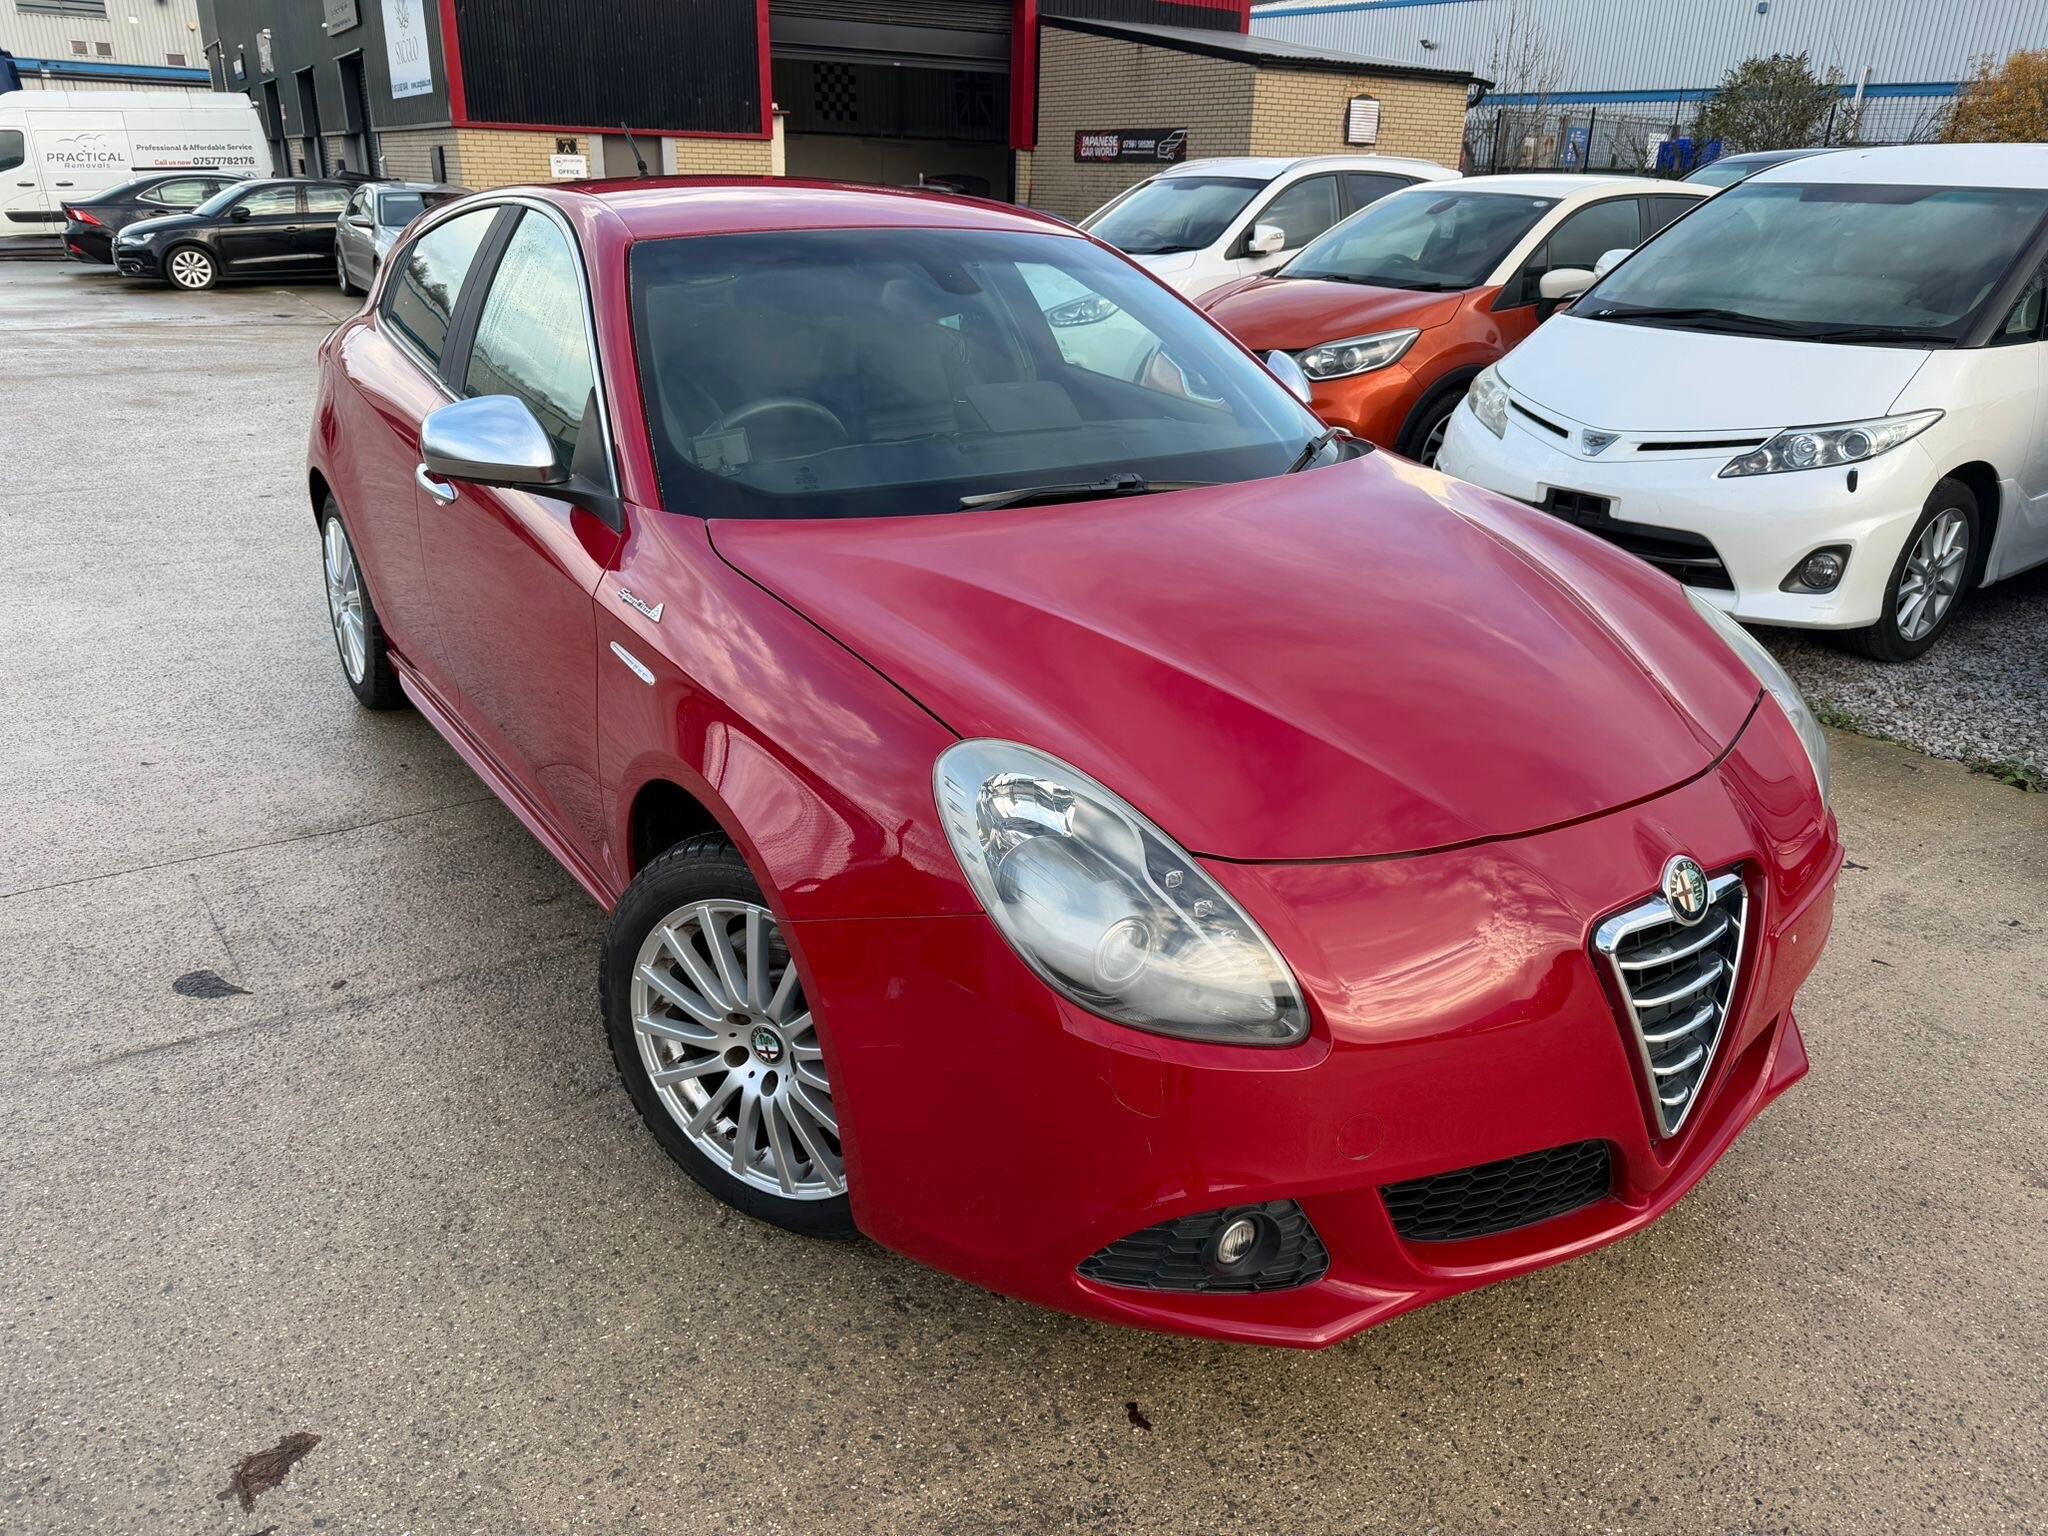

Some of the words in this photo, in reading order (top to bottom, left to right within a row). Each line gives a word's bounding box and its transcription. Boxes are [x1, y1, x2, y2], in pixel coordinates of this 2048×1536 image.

[1082, 136, 1119, 146] JAPANESE
[189, 143, 226, 151] Affordable
[226, 143, 253, 151] Service
[1081, 147, 1094, 157] CAR
[1094, 147, 1119, 157] WORLD
[46, 152, 125, 162] PRACTICAL
[154, 158, 167, 166] Call
[192, 156, 255, 166] 07577782176
[1671, 868, 1681, 898] ALFA
